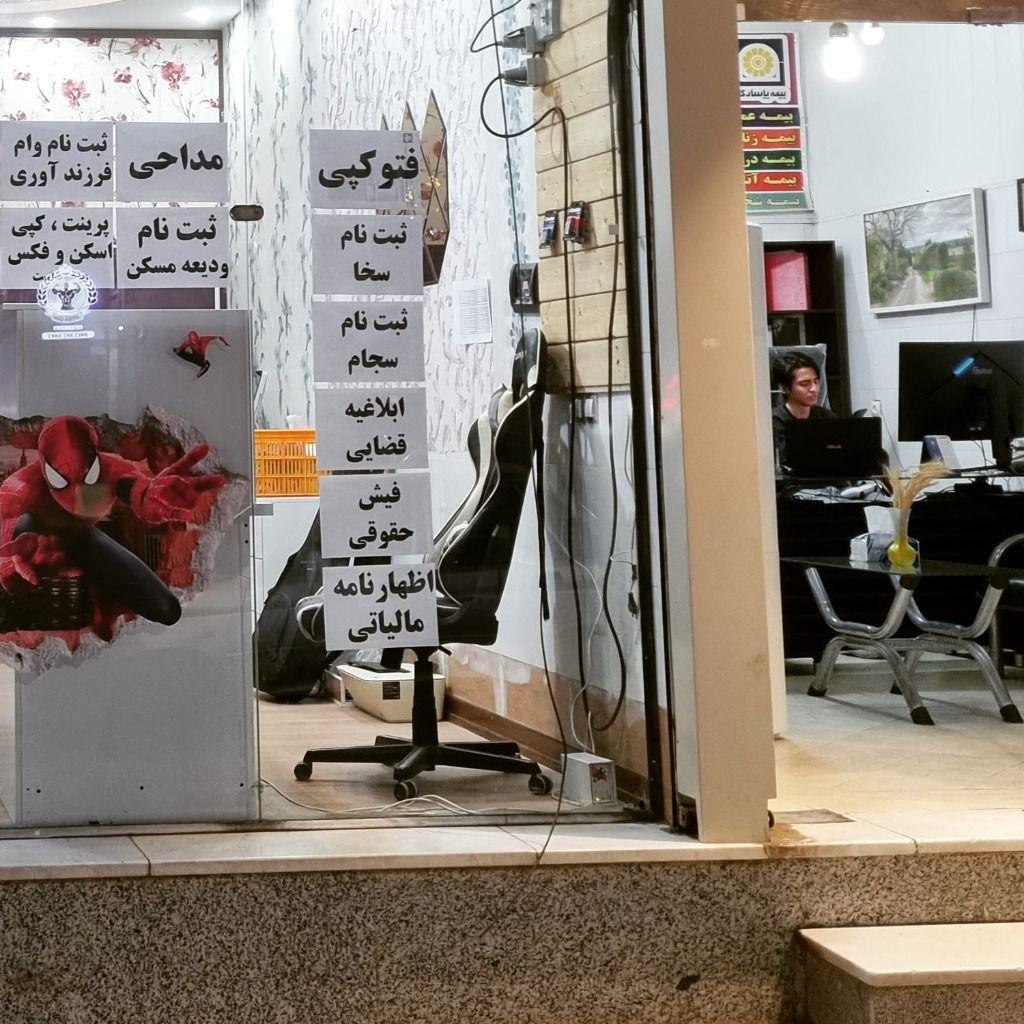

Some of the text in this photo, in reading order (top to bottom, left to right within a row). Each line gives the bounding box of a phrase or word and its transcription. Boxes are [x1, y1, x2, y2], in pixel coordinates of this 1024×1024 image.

[760, 112, 794, 124] بیمه
[14, 132, 108, 157] ثبت نام وام
[761, 134, 796, 145] بیمه
[10, 161, 113, 187] فرزند آوری
[129, 142, 224, 180] مداحی
[761, 155, 796, 167] بیمه
[763, 176, 797, 187] بیمه
[12, 214, 46, 239] کپی
[62, 217, 110, 237] پرینت
[138, 214, 217, 248] ثبت نام
[340, 222, 407, 250] ثبت نام
[7, 242, 113, 265] اسکن و فکس
[126, 256, 230, 280] ودیعه مسکن
[353, 261, 391, 282] سخا
[341, 308, 408, 337] ثبت نام
[348, 348, 399, 375] سجام
[344, 396, 405, 424] ابلاغیه
[346, 434, 408, 463] قضایی
[359, 481, 401, 511] فیش
[349, 521, 415, 550] حقوقی
[348, 609, 425, 643] مالیاتی
